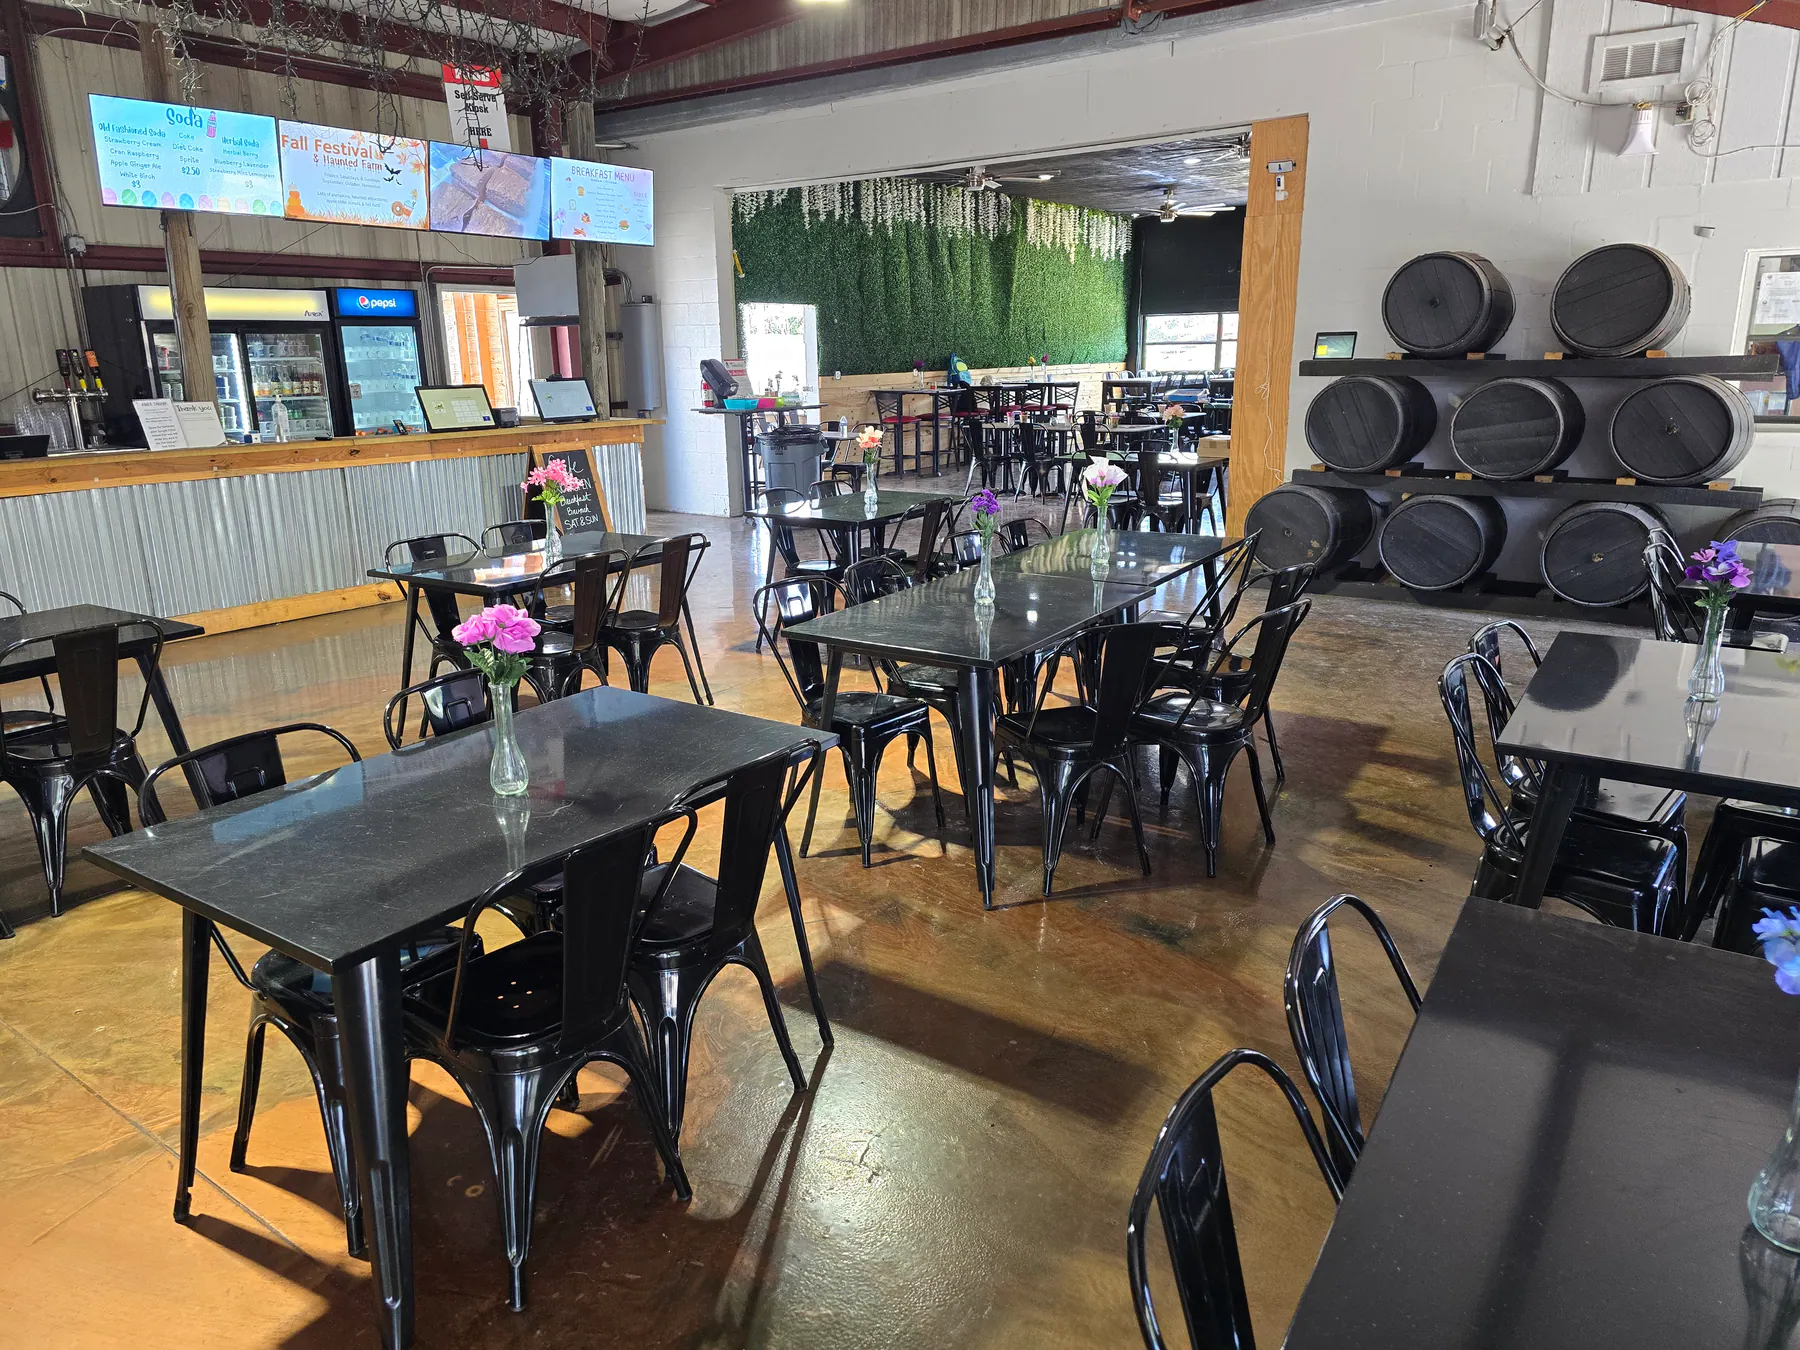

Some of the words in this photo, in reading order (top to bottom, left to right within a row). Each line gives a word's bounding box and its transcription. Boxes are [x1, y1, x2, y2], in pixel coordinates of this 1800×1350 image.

[465, 102, 489, 113] Kiosk
[166, 107, 203, 128] Soda
[98, 122, 110, 131] Old
[112, 124, 147, 136] Fashioned
[149, 128, 166, 138] Soda
[469, 127, 492, 136] HERE
[178, 132, 194, 140] Coke
[221, 136, 243, 146] Herbal
[244, 138, 259, 147] Soda
[104, 136, 140, 147] Strawberry
[142, 140, 162, 148] Cream
[281, 134, 308, 151] Fall
[314, 138, 372, 159] Festival
[127, 149, 159, 160] Raspberry
[179, 155, 199, 164] Sprite
[243, 150, 258, 159] Berry
[110, 159, 128, 167] Apple
[130, 161, 150, 170] Ginger
[213, 158, 242, 168] Blueberry
[313, 153, 319, 164] &
[323, 155, 358, 168] Haunted
[361, 160, 382, 171] Farm
[571, 165, 612, 179] BREAKFAST
[614, 172, 635, 182] MENU
[131, 180, 141, 188] $3
[244, 180, 253, 188] $3
[370, 298, 397, 309] pepsi
[175, 404, 197, 412] Thank
[559, 492, 592, 506] Breakfast
[566, 504, 592, 516] Brunch
[564, 517, 579, 530] SAT
[579, 516, 586, 526] &
[585, 514, 599, 525] SUN
